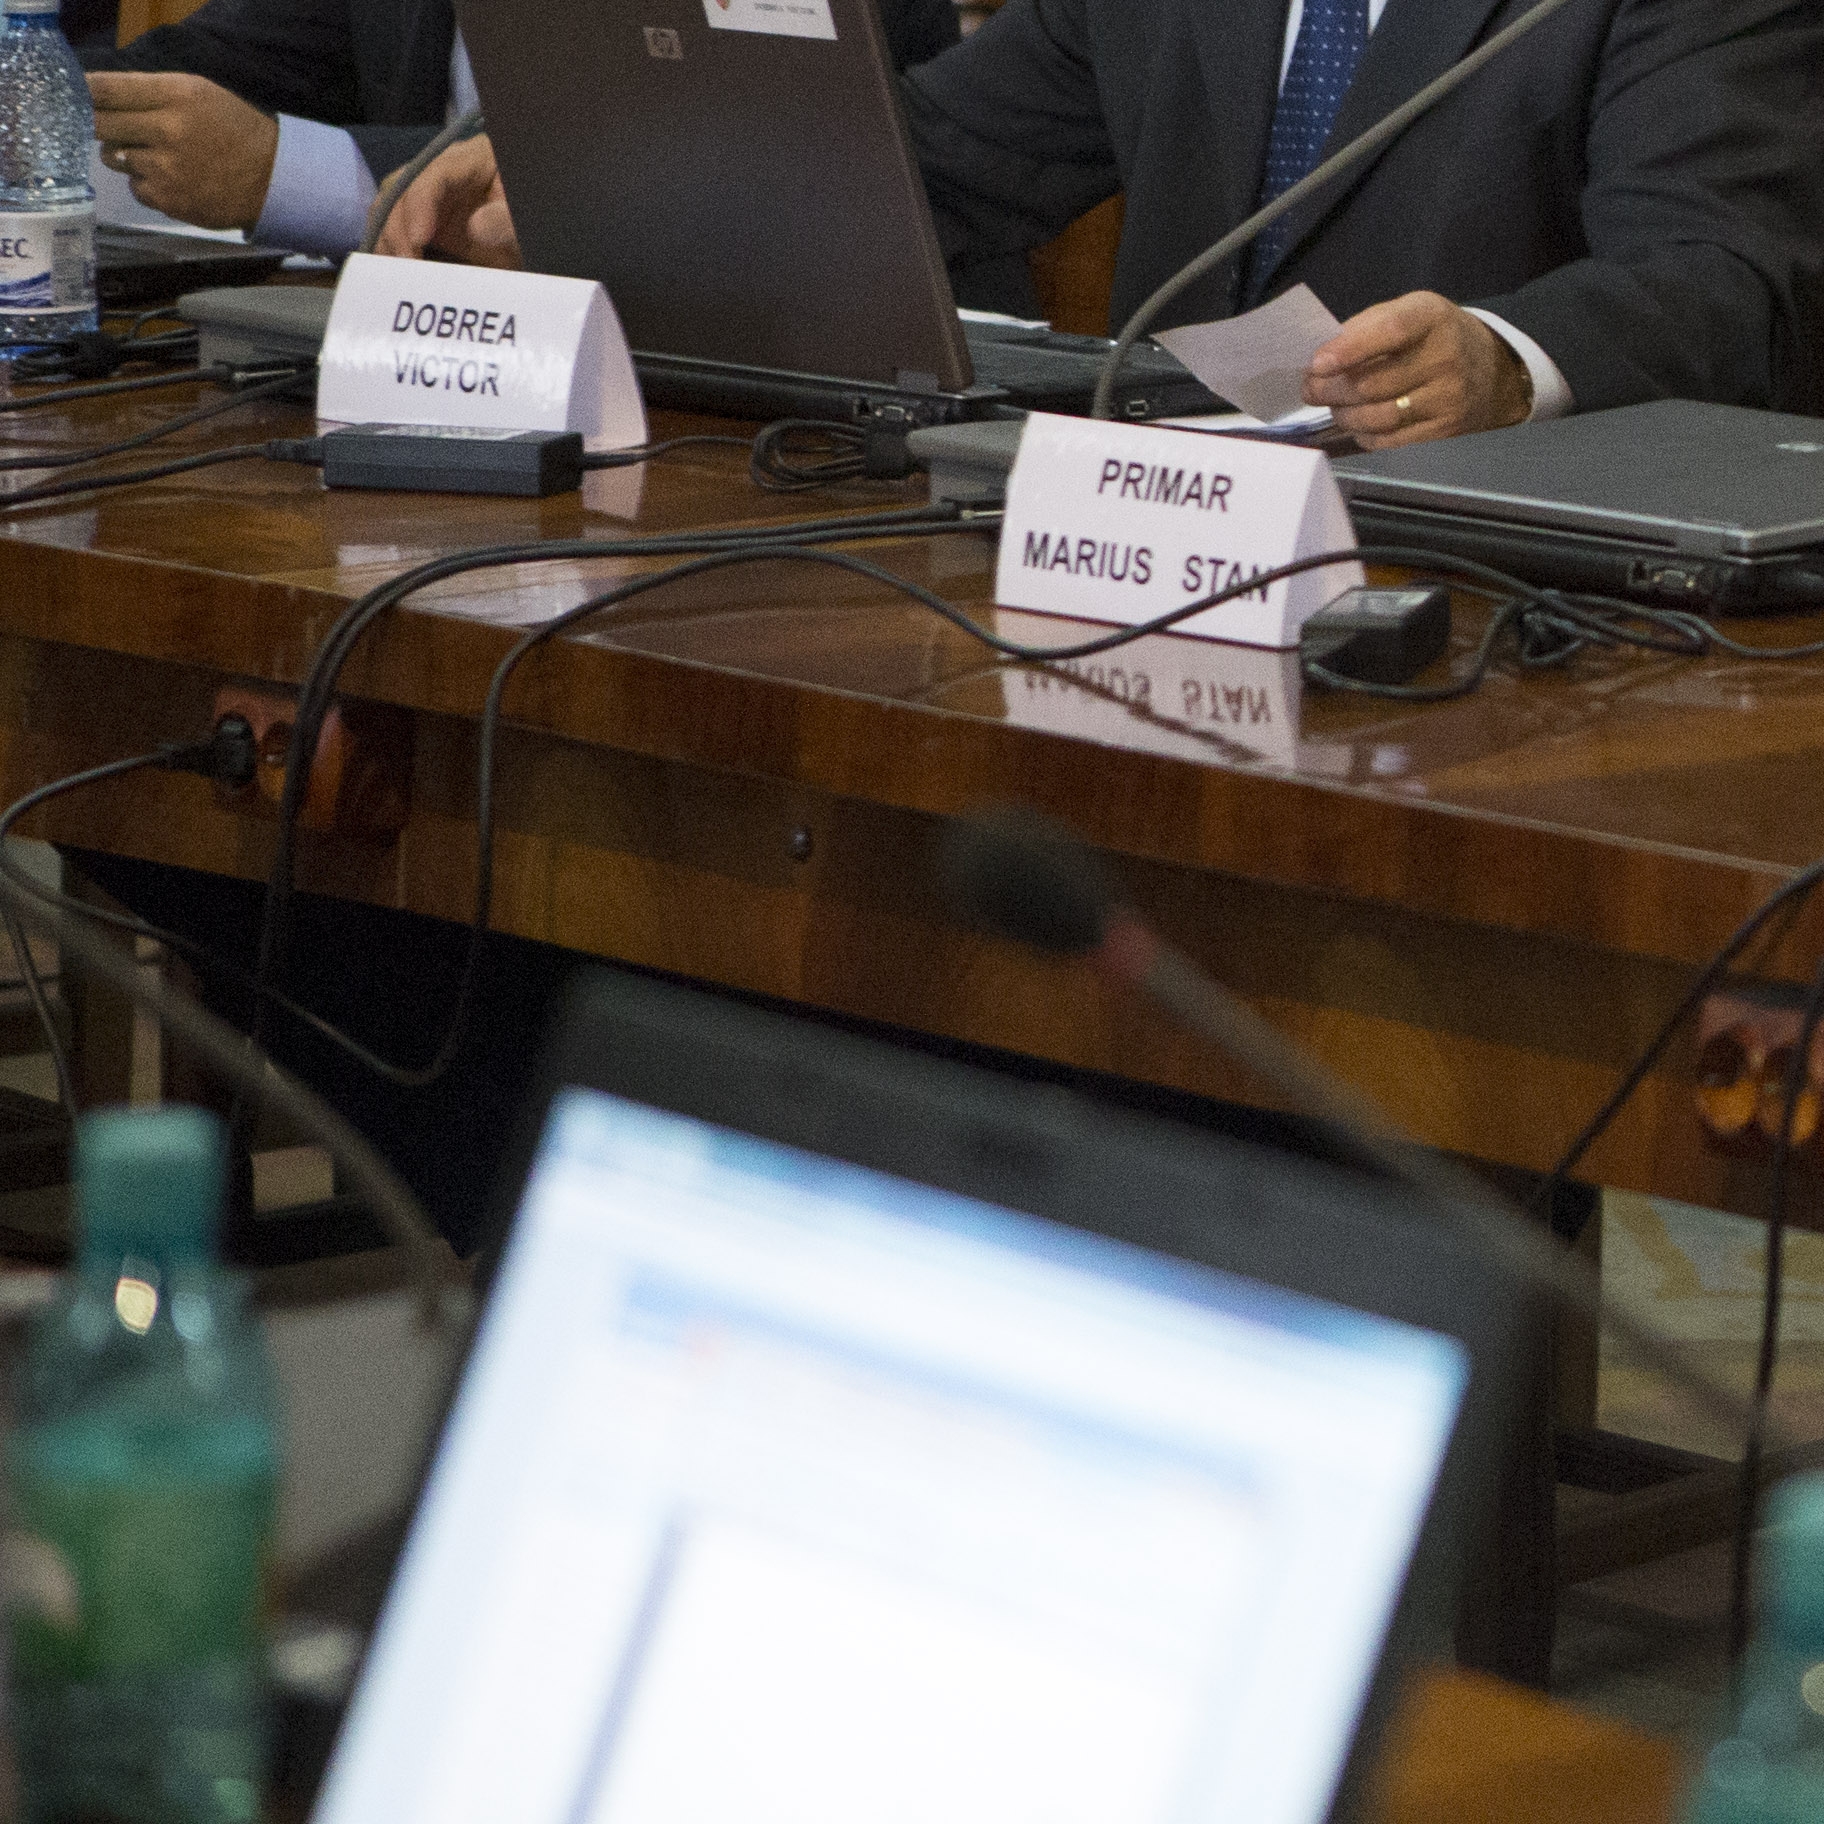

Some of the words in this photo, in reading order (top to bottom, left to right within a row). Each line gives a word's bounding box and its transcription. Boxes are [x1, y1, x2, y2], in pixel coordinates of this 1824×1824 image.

[392, 300, 517, 348] DOBREA
[394, 349, 500, 397] VICTOR
[1097, 458, 1234, 513] PRIMAR
[1022, 529, 1154, 585] MARIUS
